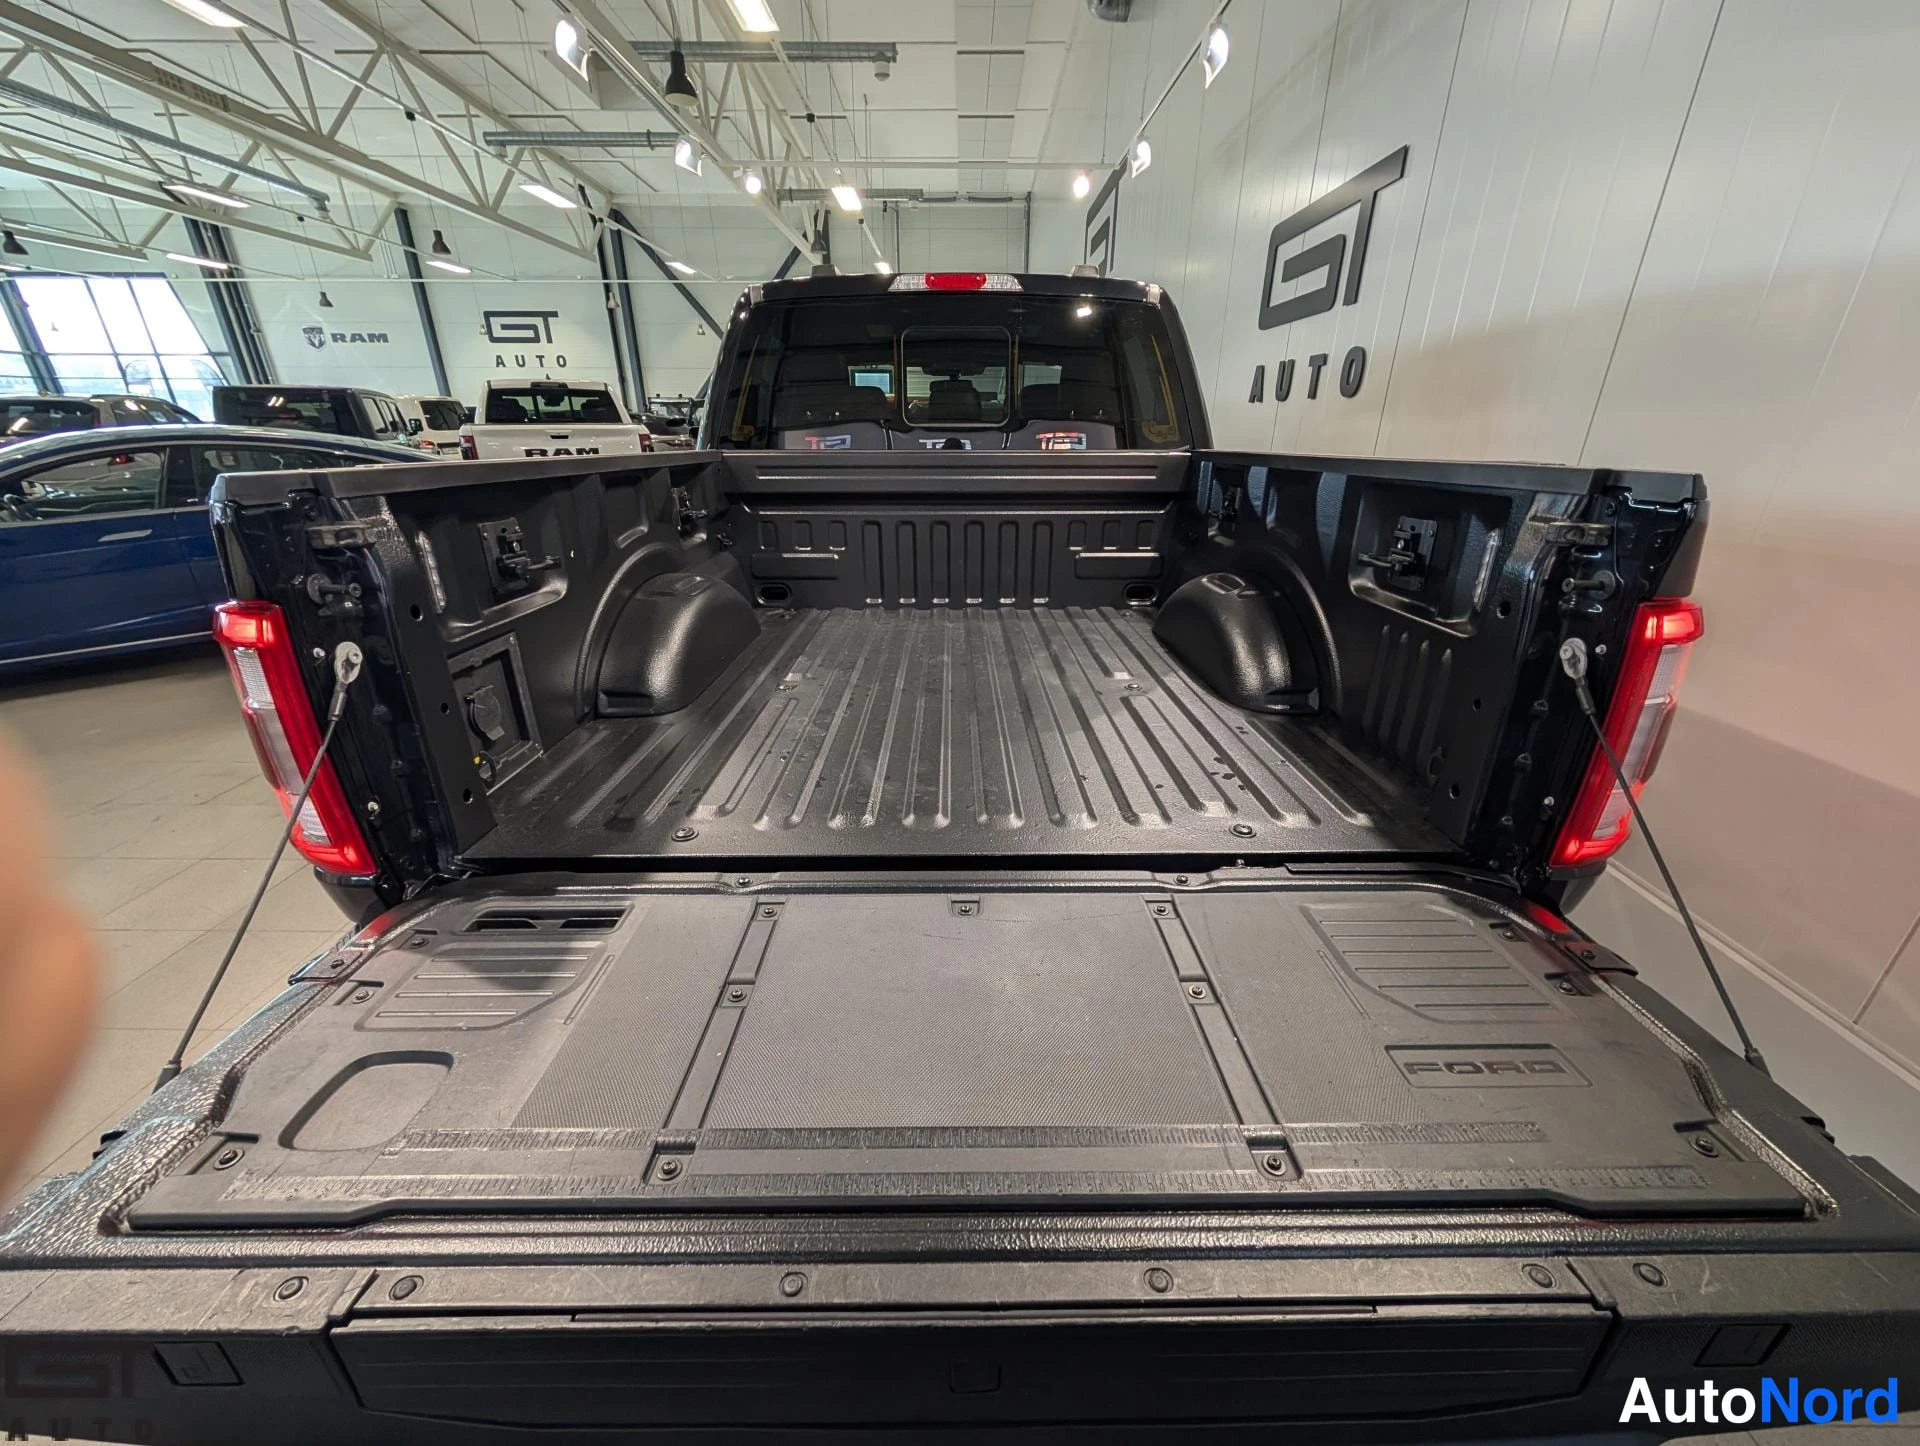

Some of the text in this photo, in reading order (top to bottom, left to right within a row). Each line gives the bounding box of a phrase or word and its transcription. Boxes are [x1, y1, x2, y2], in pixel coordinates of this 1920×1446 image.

[1258, 144, 1409, 331] GT
[483, 311, 559, 344] GT
[331, 332, 389, 344] RAM
[495, 354, 567, 368] AUTO
[1248, 346, 1367, 403] AUTO
[524, 447, 600, 458] RAM
[1403, 1060, 1568, 1075] FORD
